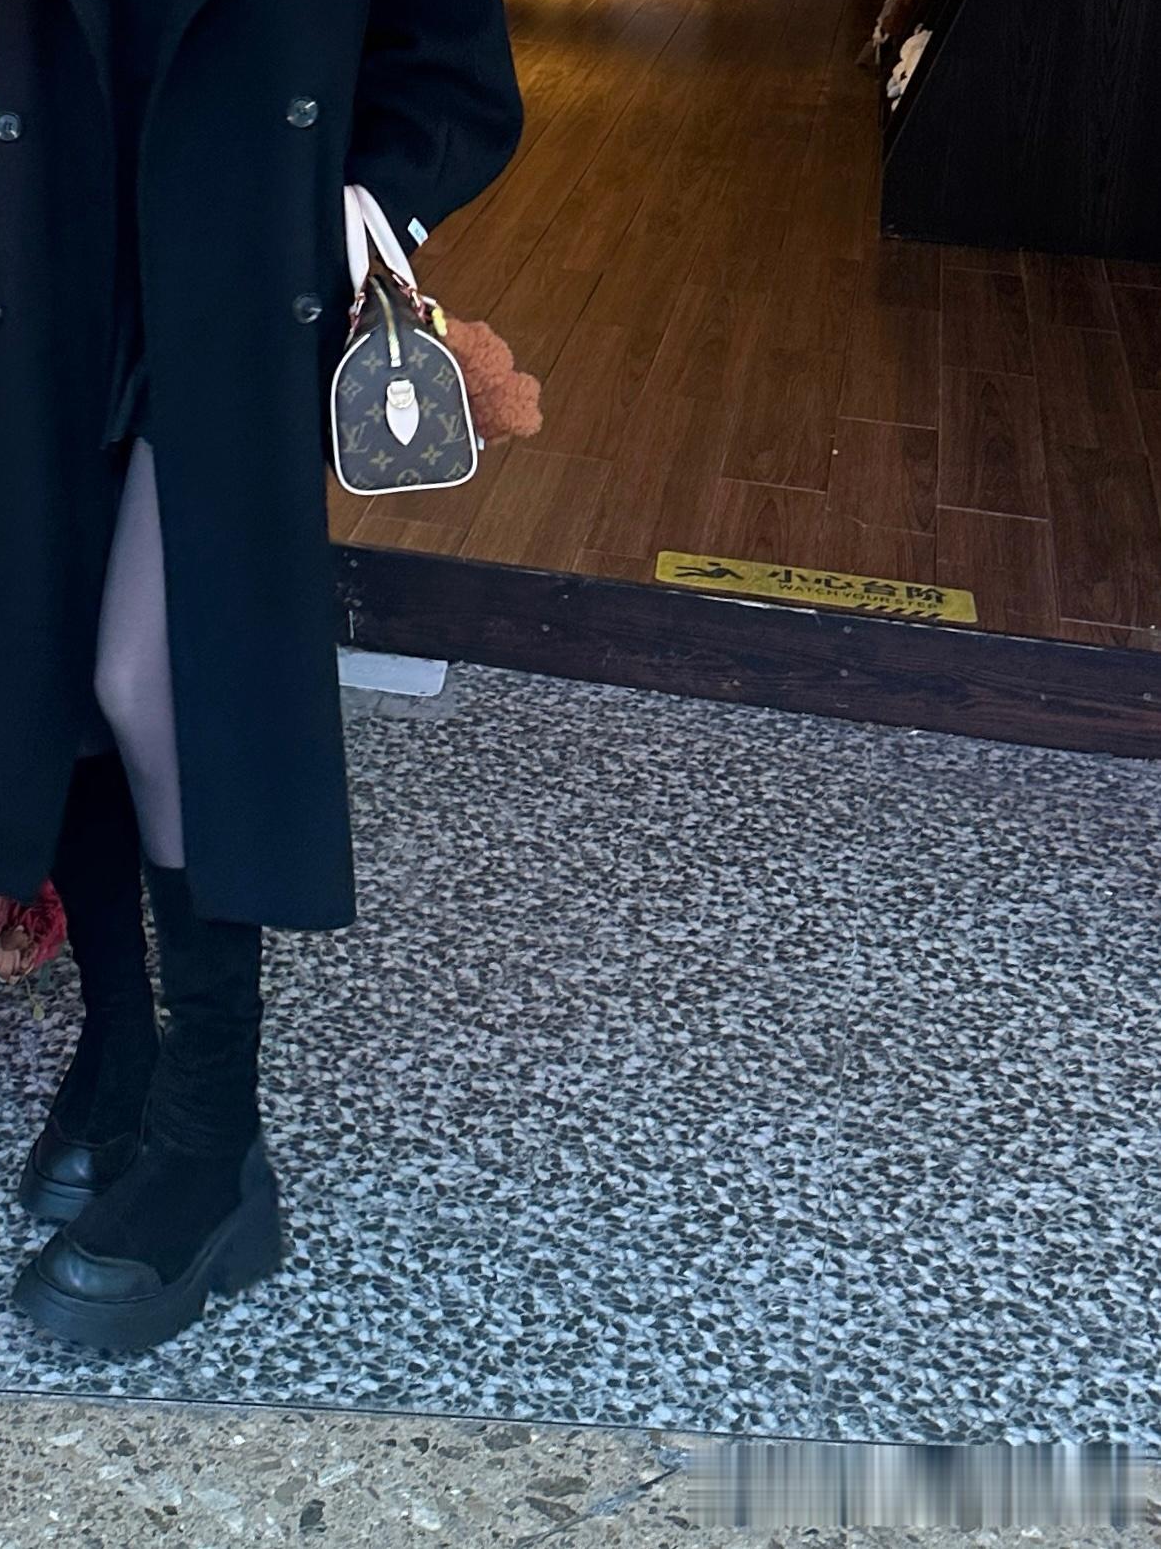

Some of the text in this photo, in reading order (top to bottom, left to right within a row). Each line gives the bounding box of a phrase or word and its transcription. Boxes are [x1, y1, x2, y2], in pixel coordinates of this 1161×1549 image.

[767, 569, 947, 604] 小心台阶
[778, 583, 939, 609] WATCH YOUR STEP
